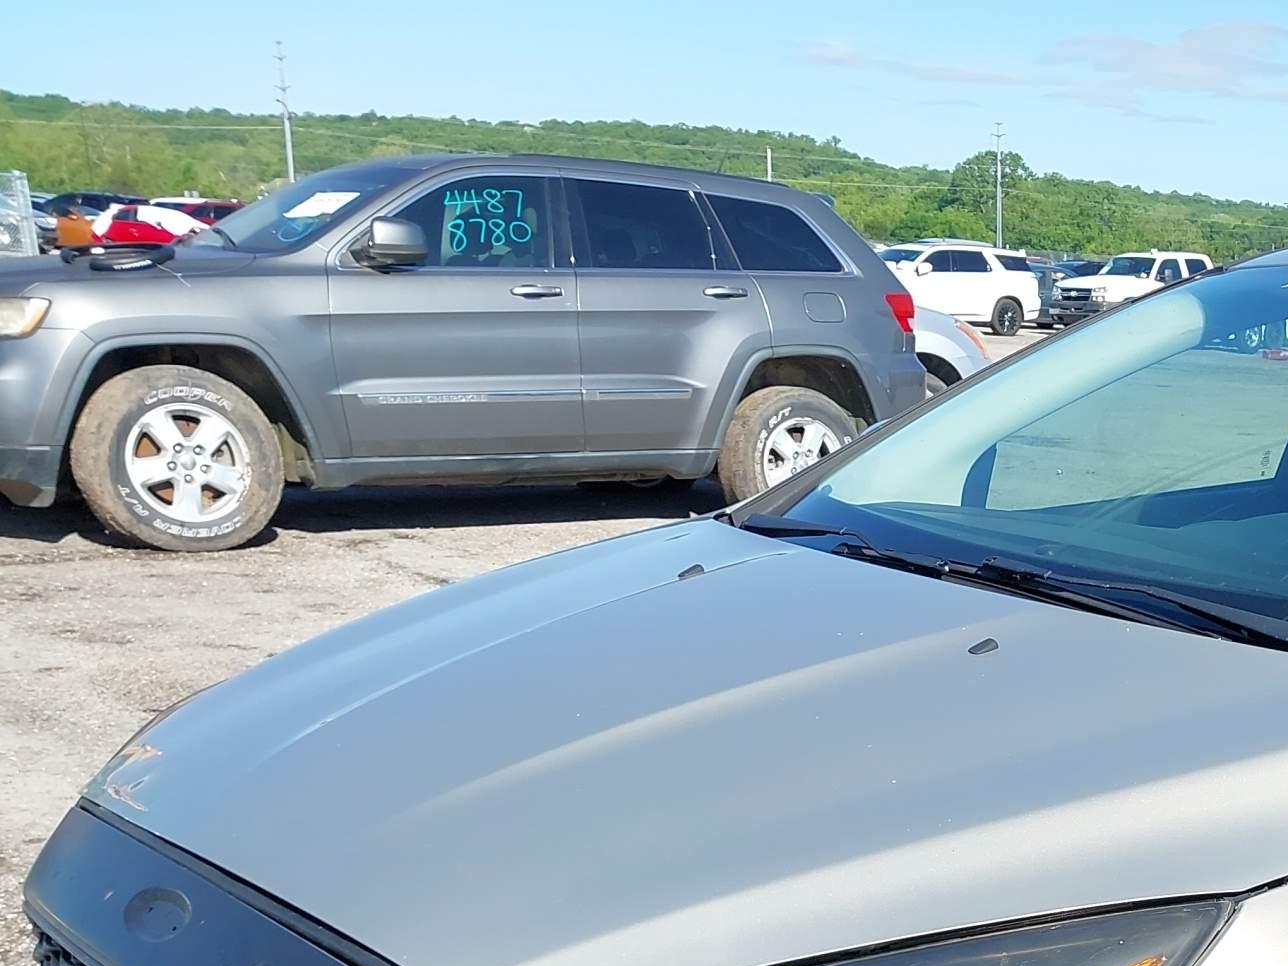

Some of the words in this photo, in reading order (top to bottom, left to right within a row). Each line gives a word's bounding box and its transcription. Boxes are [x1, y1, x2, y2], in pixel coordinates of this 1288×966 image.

[443, 188, 523, 217] 4487
[447, 219, 532, 252] 8780
[144, 386, 233, 412] COOPER
